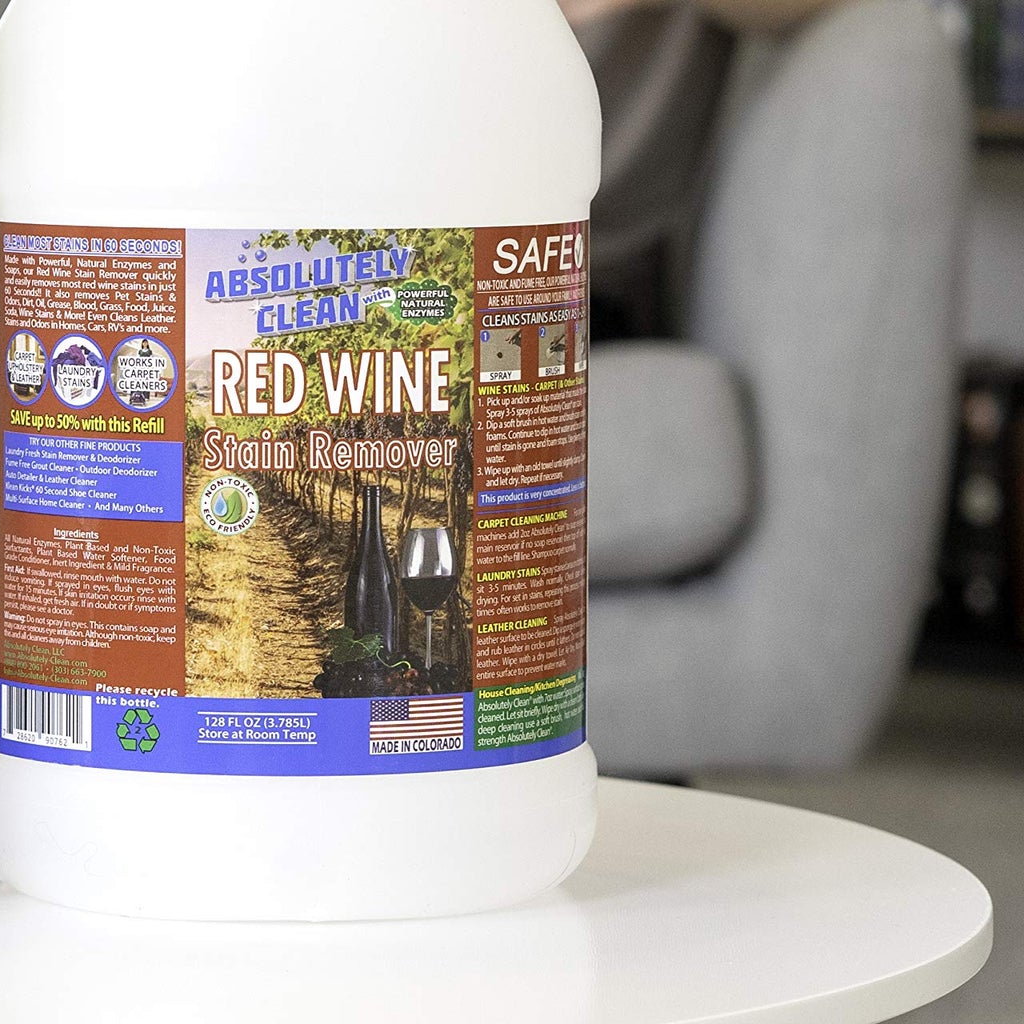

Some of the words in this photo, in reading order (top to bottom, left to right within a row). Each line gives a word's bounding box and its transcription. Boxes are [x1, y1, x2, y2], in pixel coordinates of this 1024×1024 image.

[3, 234, 26, 249] CLEAN
[27, 235, 52, 250] MOST
[53, 236, 89, 251] STAINS
[91, 238, 102, 252] IN
[104, 238, 118, 252] 60
[120, 239, 182, 254] SECONDS!
[493, 234, 574, 274] SAFE
[4, 255, 19, 265] Made
[22, 256, 36, 266] with
[39, 256, 73, 268] Powerful,
[77, 258, 107, 268] Natural
[112, 259, 152, 271] Enzymes
[158, 260, 176, 270] and
[23, 268, 34, 276] our
[36, 267, 50, 276] Red
[52, 267, 71, 278] Wine
[75, 268, 95, 278] Stain
[99, 269, 138, 280] Remover
[142, 271, 176, 282] quickly
[204, 248, 413, 301] ABSOLUTELY
[32, 279, 60, 288] removes
[61, 280, 81, 289] most
[82, 280, 96, 290] red
[97, 281, 118, 290] wine
[120, 281, 146, 291] stains
[148, 281, 157, 291] in
[158, 282, 176, 293] just
[55, 289, 70, 298] also
[74, 291, 110, 300] removes
[115, 291, 130, 301] Pet
[135, 292, 163, 302] Stains
[168, 293, 176, 302] &
[362, 288, 391, 305] with
[397, 290, 449, 298] POWERFUL
[47, 299, 72, 310] Grease,
[73, 300, 98, 311] Blood,
[99, 301, 124, 312] Grass,
[125, 302, 150, 313] Food,
[152, 302, 176, 314] Juice,
[401, 299, 445, 307] NATURAL
[18, 307, 34, 318] Wine
[35, 308, 54, 319] Stains
[64, 310, 86, 320] More!
[87, 311, 108, 321] Even
[109, 312, 138, 322] Cleans
[141, 313, 176, 323] Leather.
[256, 292, 364, 336] CLEAN
[402, 309, 445, 318] ENZYMES
[481, 313, 520, 327] CLEANS
[520, 311, 548, 325] STAINS
[31, 318, 50, 329] Odors
[58, 320, 87, 332] Homes,
[87, 321, 107, 333] Cars,
[126, 323, 143, 333] and
[144, 325, 171, 334] more.
[14, 351, 35, 362] CARPET
[119, 357, 153, 367] WORKS
[155, 358, 165, 367] IN
[58, 366, 96, 376] LAUNDRY
[124, 369, 160, 379] CARPET
[489, 371, 512, 381] SPRAY
[63, 377, 91, 388] STAINS
[118, 380, 166, 390] CLEANERS
[211, 349, 306, 416] RED
[318, 348, 451, 416] WINE
[478, 385, 501, 395] WINE
[502, 383, 530, 395] STAINS
[486, 396, 501, 407] Pick
[501, 397, 510, 407] up
[486, 408, 504, 419] Spray
[10, 409, 31, 426] SAVE
[31, 415, 44, 431] up
[45, 414, 56, 429] to
[57, 413, 80, 430] 50%
[81, 414, 107, 431] with
[108, 415, 131, 433] this
[132, 417, 165, 434] Refill
[486, 420, 497, 431] Dip
[29, 436, 40, 446] TRY
[40, 438, 55, 447] OUR
[55, 439, 78, 449] OTHER
[79, 440, 96, 450] FINE
[97, 441, 141, 452] PRODUCTS
[203, 428, 296, 470] Stain
[309, 430, 457, 470] Remover
[41, 450, 57, 459] Stain
[58, 451, 89, 461] Remover
[97, 453, 141, 464] Deodorizer
[49, 462, 74, 473] Cleaner
[79, 464, 111, 475] Outdoor
[112, 466, 158, 477] Deodorizer
[44, 475, 69, 484] Leather
[70, 476, 97, 486] Cleaner
[44, 486, 68, 496] Second
[69, 487, 87, 497] Shoe
[88, 489, 117, 499] Cleaner
[205, 478, 254, 497] NON-TOXIC
[480, 493, 496, 504] This
[497, 490, 524, 504] product
[38, 497, 57, 507] Home
[58, 499, 85, 509] Cleaner
[95, 501, 110, 511] And
[112, 502, 134, 514] Many
[135, 503, 164, 514] Others
[477, 518, 509, 529] CARPET
[510, 513, 545, 526] CLEANING
[53, 527, 99, 540] Ingredients
[113, 545, 129, 553] and
[133, 544, 176, 555] Non-Toxic
[82, 550, 105, 561] Water
[154, 555, 176, 564] Food
[132, 564, 175, 574] Fragrance.
[477, 570, 516, 582] LAUNDRY
[516, 566, 541, 579] STAINS
[105, 574, 122, 583] with
[162, 578, 176, 586] not
[157, 586, 176, 595] with
[157, 594, 176, 604] with
[134, 603, 176, 613] symptoms
[89, 620, 104, 629] This
[139, 625, 159, 634] soap
[160, 625, 176, 634] and
[477, 621, 514, 634] LEATHER
[514, 616, 548, 630] CLEANING
[156, 634, 176, 644] keep
[95, 683, 132, 695] Please
[135, 686, 178, 698] recycle
[478, 689, 504, 699] House
[95, 695, 117, 706] this
[120, 696, 160, 708] bottle.
[477, 699, 513, 712] Absolutely
[204, 716, 225, 727] 128
[228, 717, 241, 727] FL
[243, 717, 261, 728] OZ
[263, 717, 311, 729] (3.785L)
[16, 731, 36, 742] 28620
[45, 735, 68, 747] 90762
[198, 727, 229, 739] Store
[231, 729, 243, 739] at
[246, 729, 280, 740] Room
[282, 729, 316, 742] Temp
[477, 735, 507, 747] strength
[371, 741, 399, 753] MADE
[401, 740, 411, 752] IN
[412, 737, 461, 752] COLORADO
